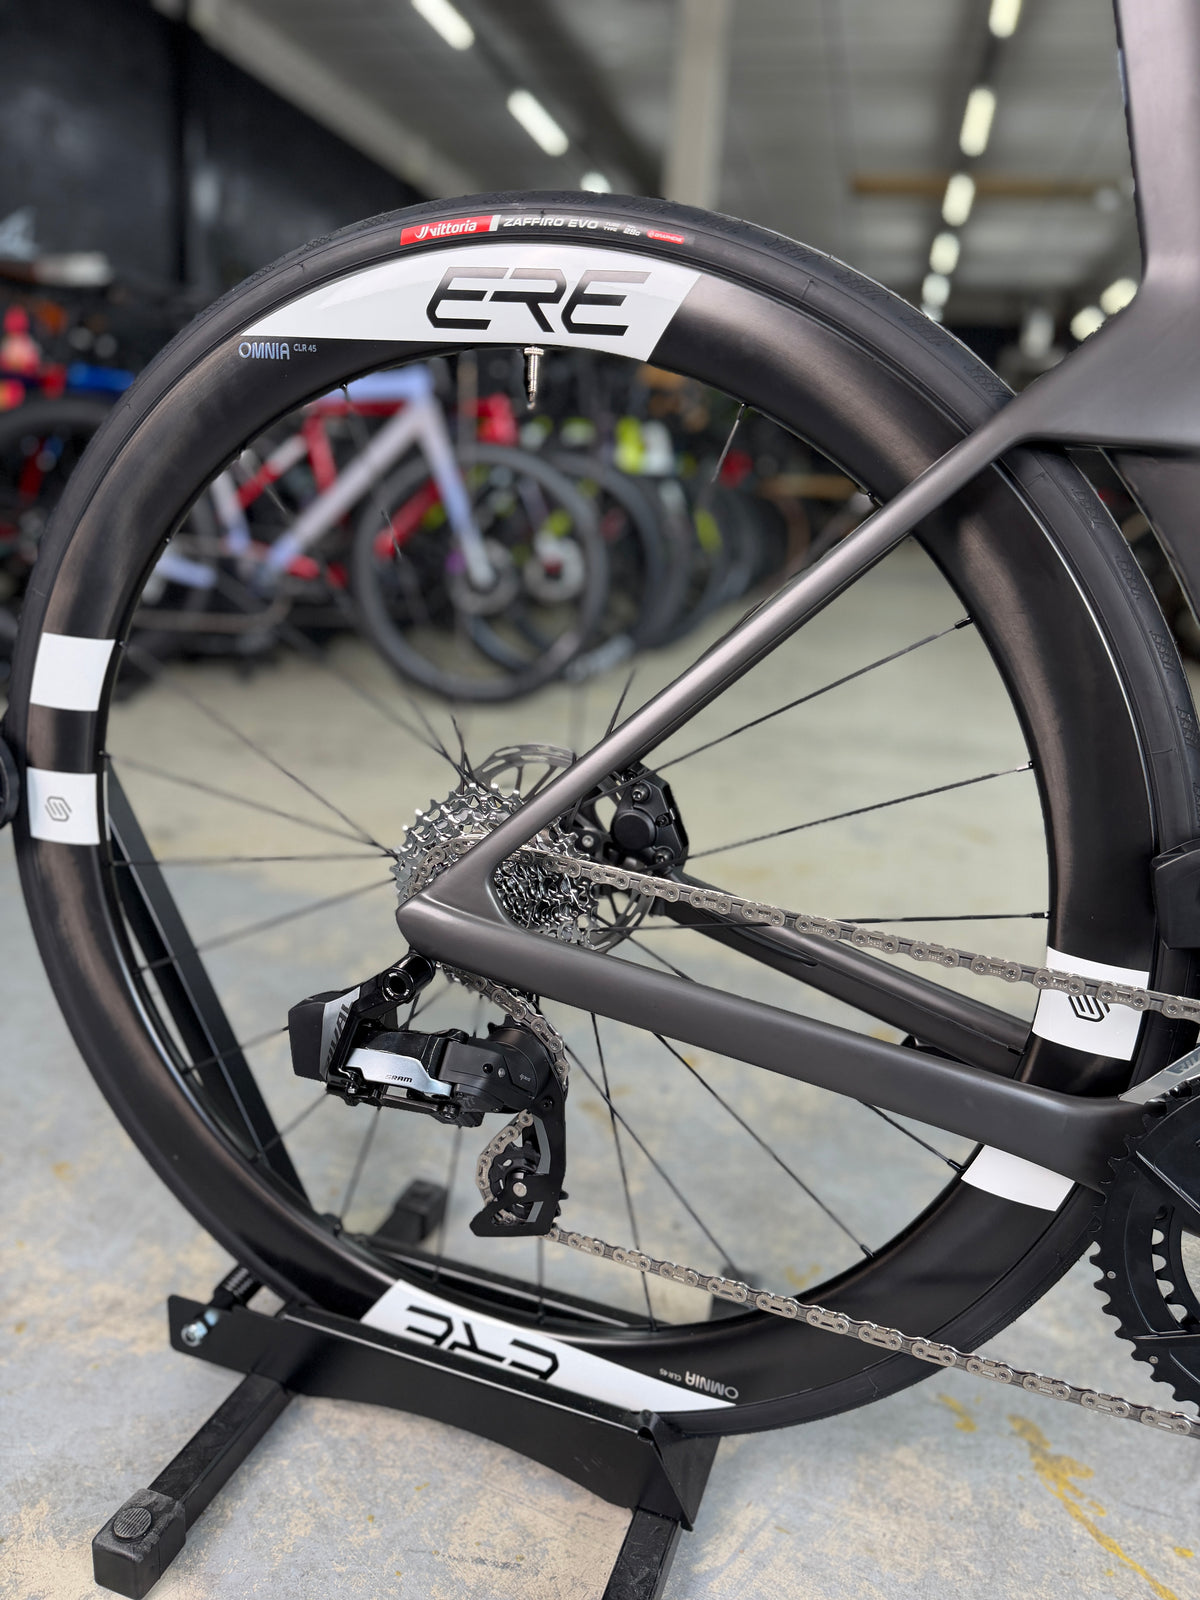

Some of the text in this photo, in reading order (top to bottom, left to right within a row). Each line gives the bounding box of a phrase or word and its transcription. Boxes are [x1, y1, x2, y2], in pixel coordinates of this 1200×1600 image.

[429, 220, 477, 236] vittoria
[503, 217, 599, 229] ZAFFIRO EVO
[426, 266, 651, 336] ERE
[238, 342, 290, 359] OMNIA
[293, 344, 307, 352] CLR
[685, 1371, 739, 1399] OMNIA
